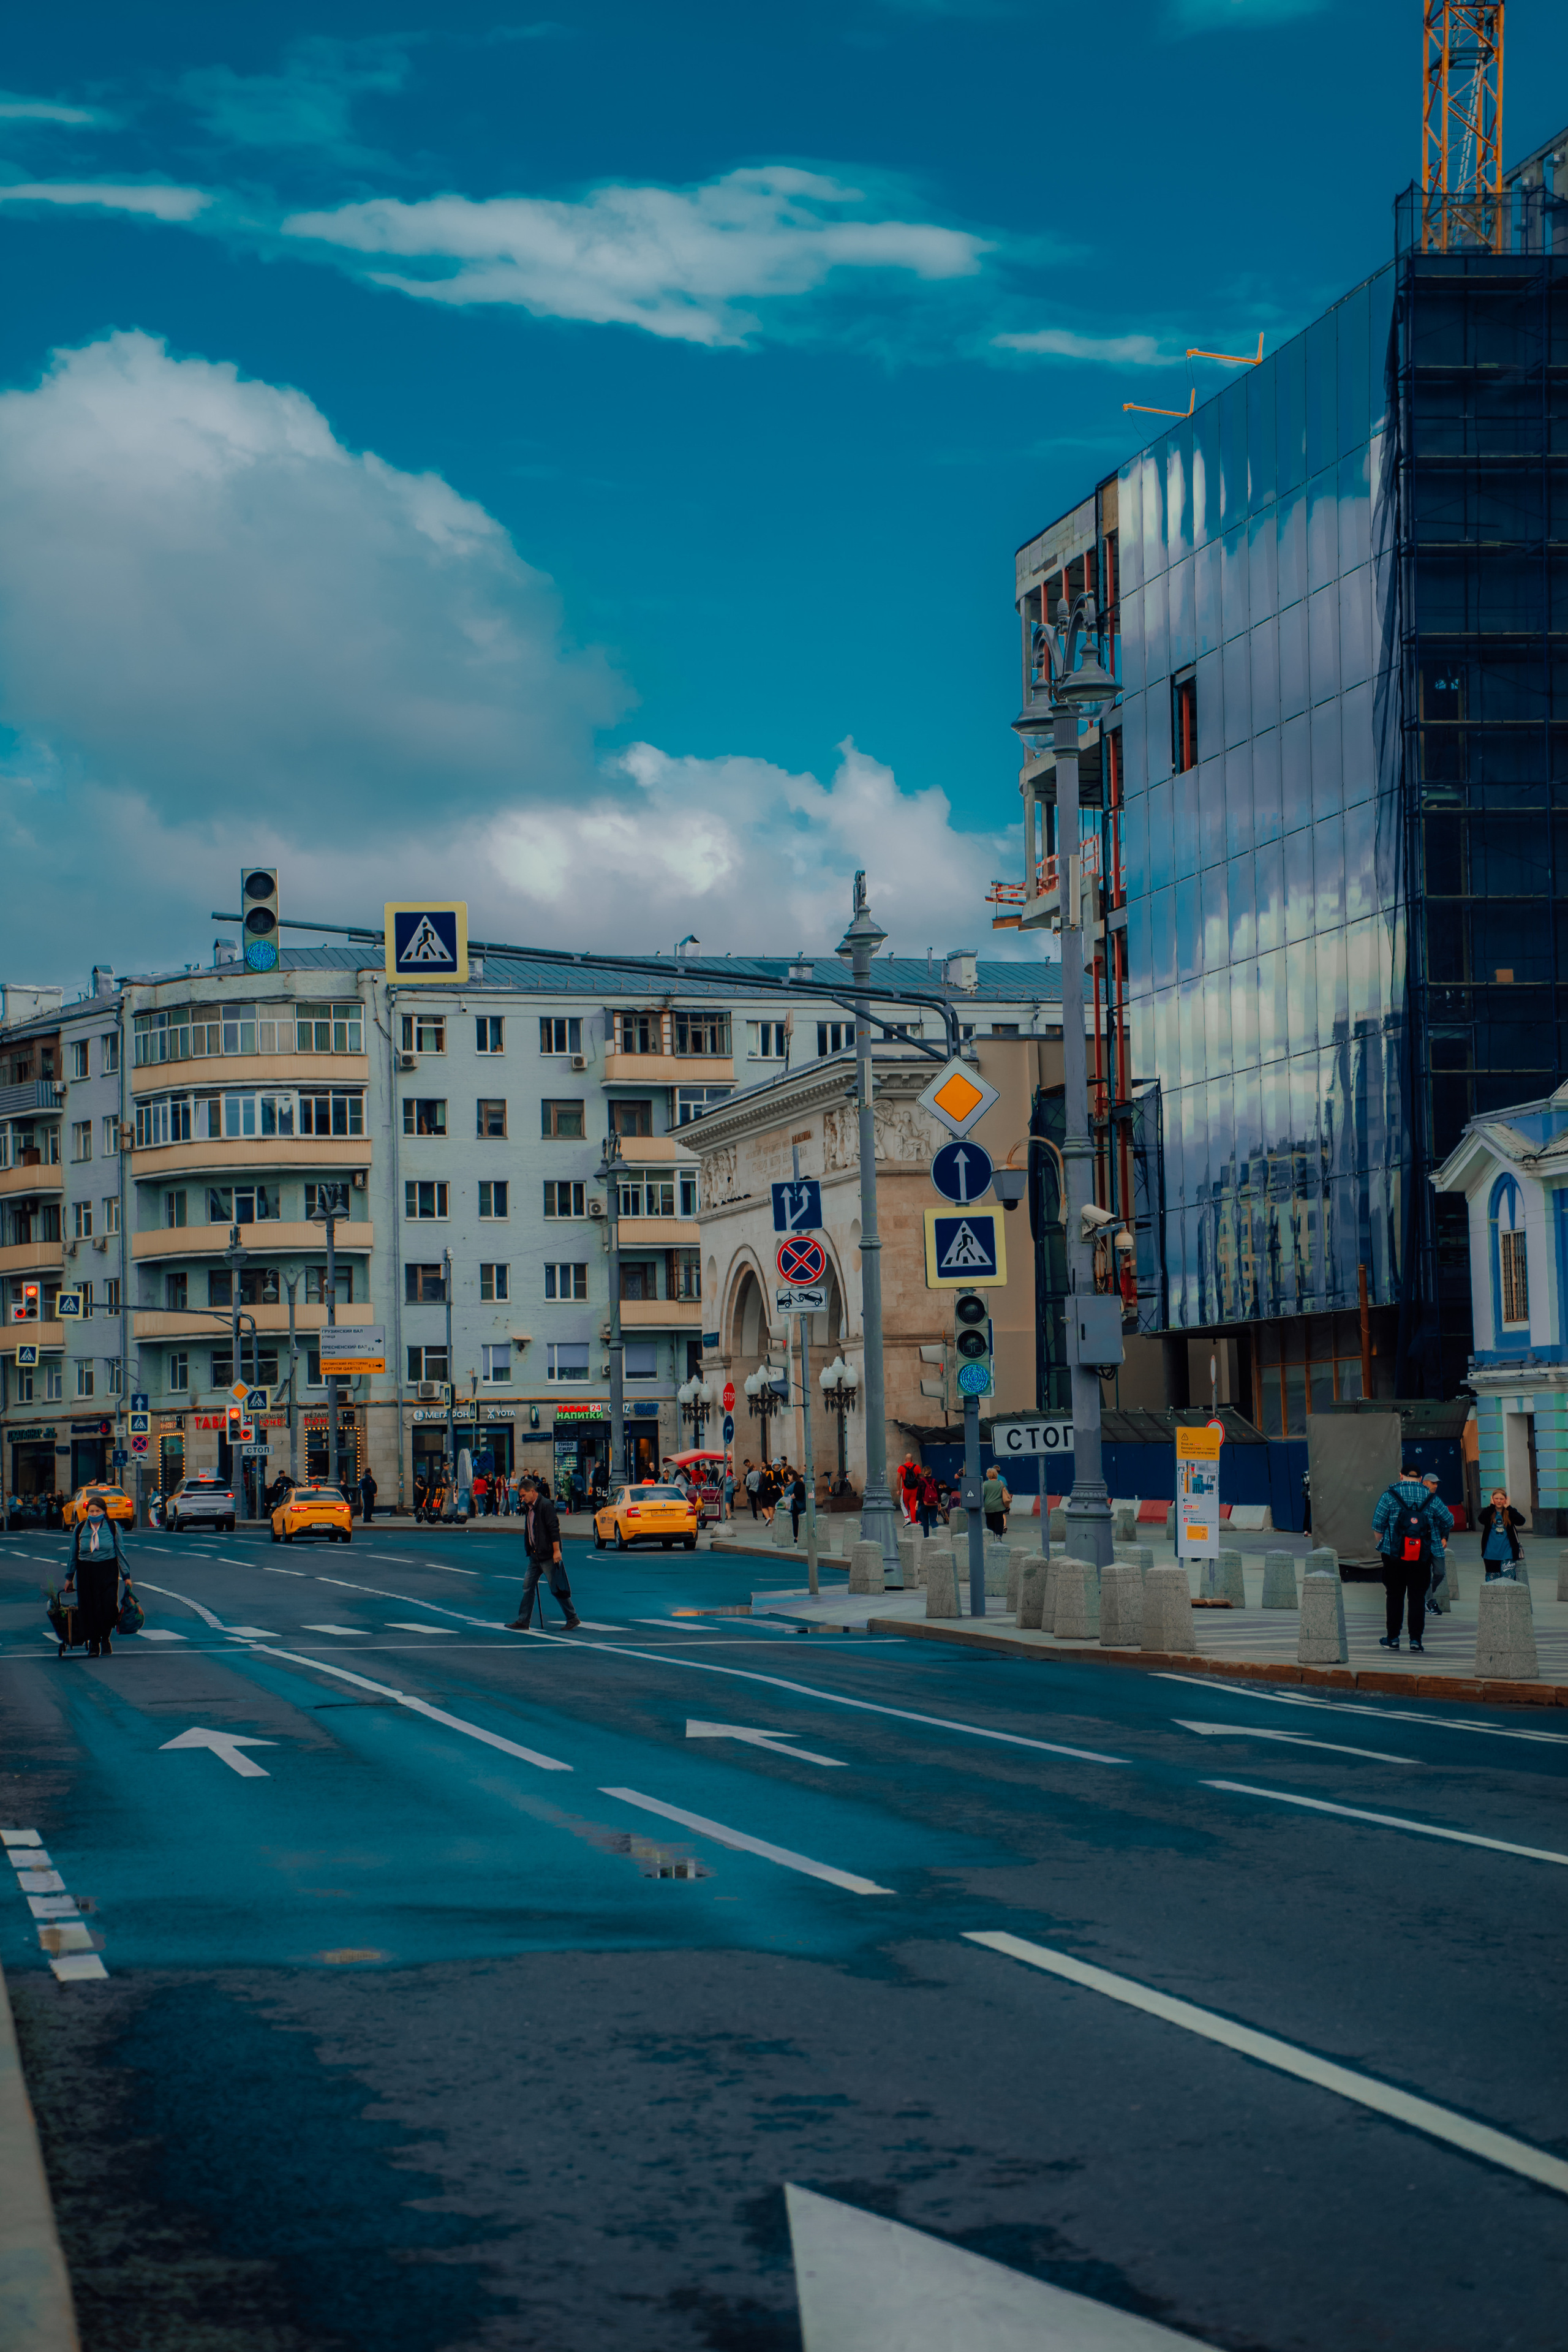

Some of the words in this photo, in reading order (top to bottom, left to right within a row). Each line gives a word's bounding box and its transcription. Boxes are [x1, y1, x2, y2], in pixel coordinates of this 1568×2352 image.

[724, 1392, 735, 1402] STOP
[194, 1415, 227, 1430] ТАБА
[596, 1487, 608, 1497] 92
